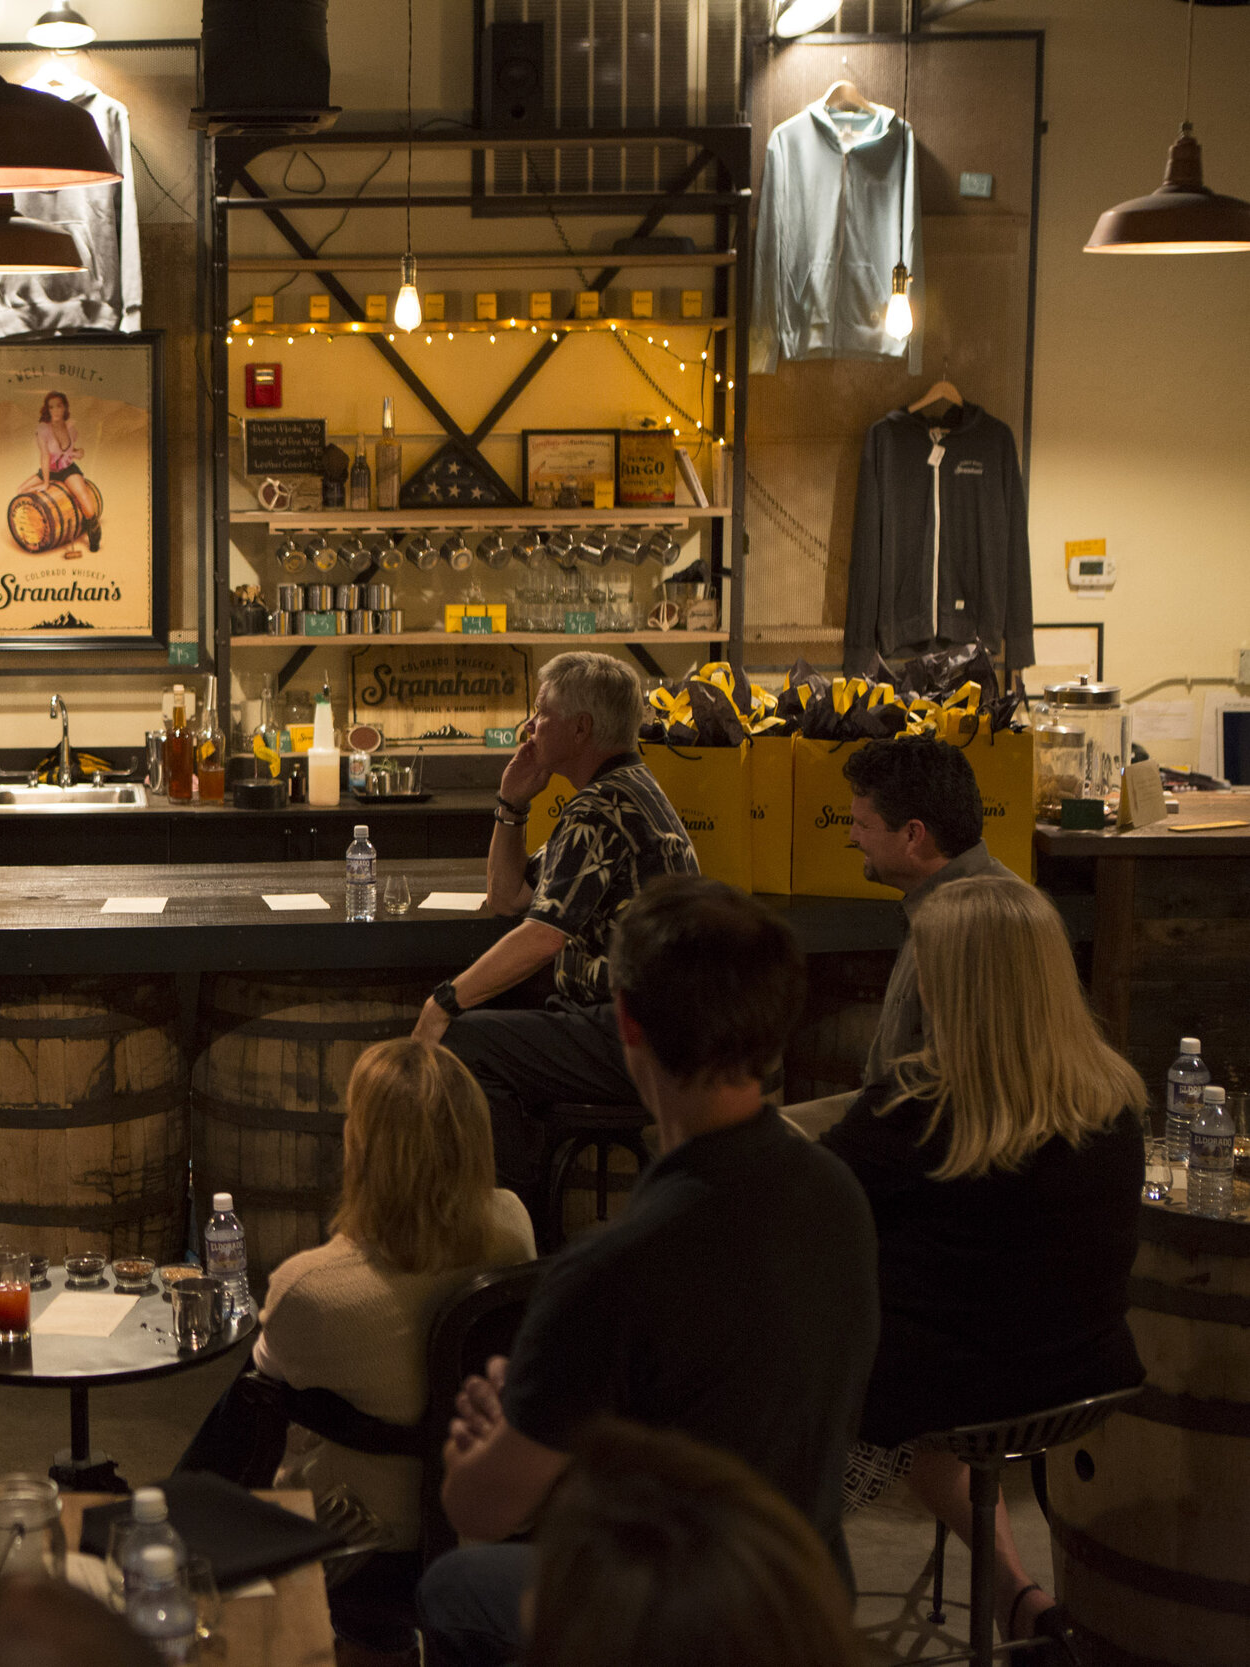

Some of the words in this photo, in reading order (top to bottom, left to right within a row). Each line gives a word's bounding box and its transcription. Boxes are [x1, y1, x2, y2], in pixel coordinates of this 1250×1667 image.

[59, 364, 97, 382] BUILT
[25, 569, 67, 581] COLORADO
[72, 569, 106, 580] WHISKEY
[361, 663, 516, 706] Stranahan's
[487, 730, 514, 745] $90
[1194, 1135, 1232, 1147] ELDORADO
